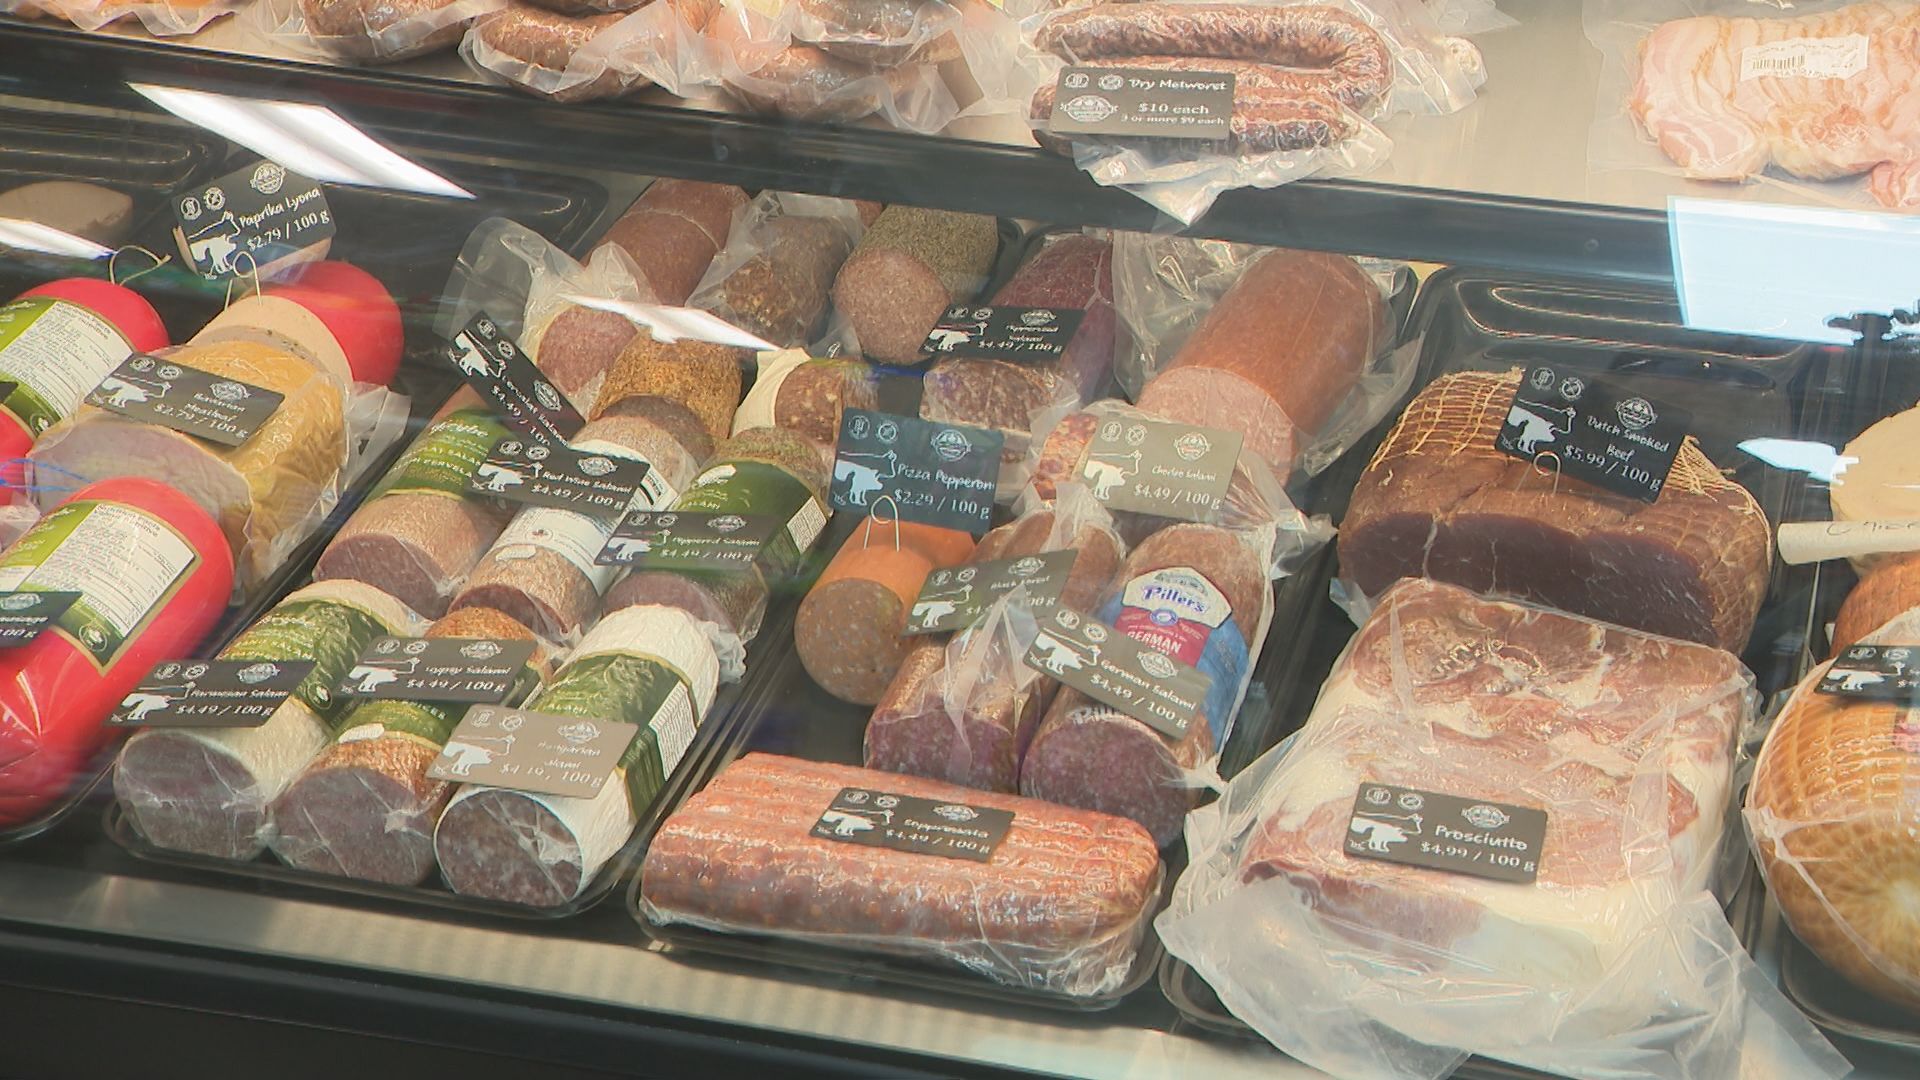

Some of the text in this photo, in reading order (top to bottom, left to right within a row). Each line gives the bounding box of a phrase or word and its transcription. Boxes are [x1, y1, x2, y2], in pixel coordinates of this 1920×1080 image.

[1128, 78, 1155, 90] Dry
[1138, 103, 1210, 115] $10 each
[1197, 116, 1224, 125] each
[239, 202, 285, 229] Paprika
[246, 228, 281, 251] $2.79
[293, 211, 319, 233] 100
[1027, 343, 1052, 351] 100
[1623, 430, 1670, 453] Smoked
[898, 463, 932, 482] Pizza
[1563, 444, 1605, 469] $5.99
[1621, 465, 1650, 485] 100
[531, 483, 572, 499] $4.49
[586, 495, 614, 507] 100
[893, 488, 935, 507] $2.29
[951, 498, 979, 515] 100
[1133, 483, 1171, 500] $4.49
[1186, 492, 1211, 506] 100
[1143, 586, 1207, 613] Piller's
[464, 681, 495, 691] 100
[1100, 659, 1151, 690] German
[1090, 673, 1133, 699] $4.49
[1147, 703, 1176, 721] 100
[175, 704, 218, 716] $4.49
[235, 705, 262, 716] 100
[885, 829, 929, 844] $4.49
[947, 838, 978, 851] 100
[1435, 825, 1528, 851] Prosciutto
[1420, 840, 1468, 858] $4.99
[1489, 853, 1520, 868] 100
